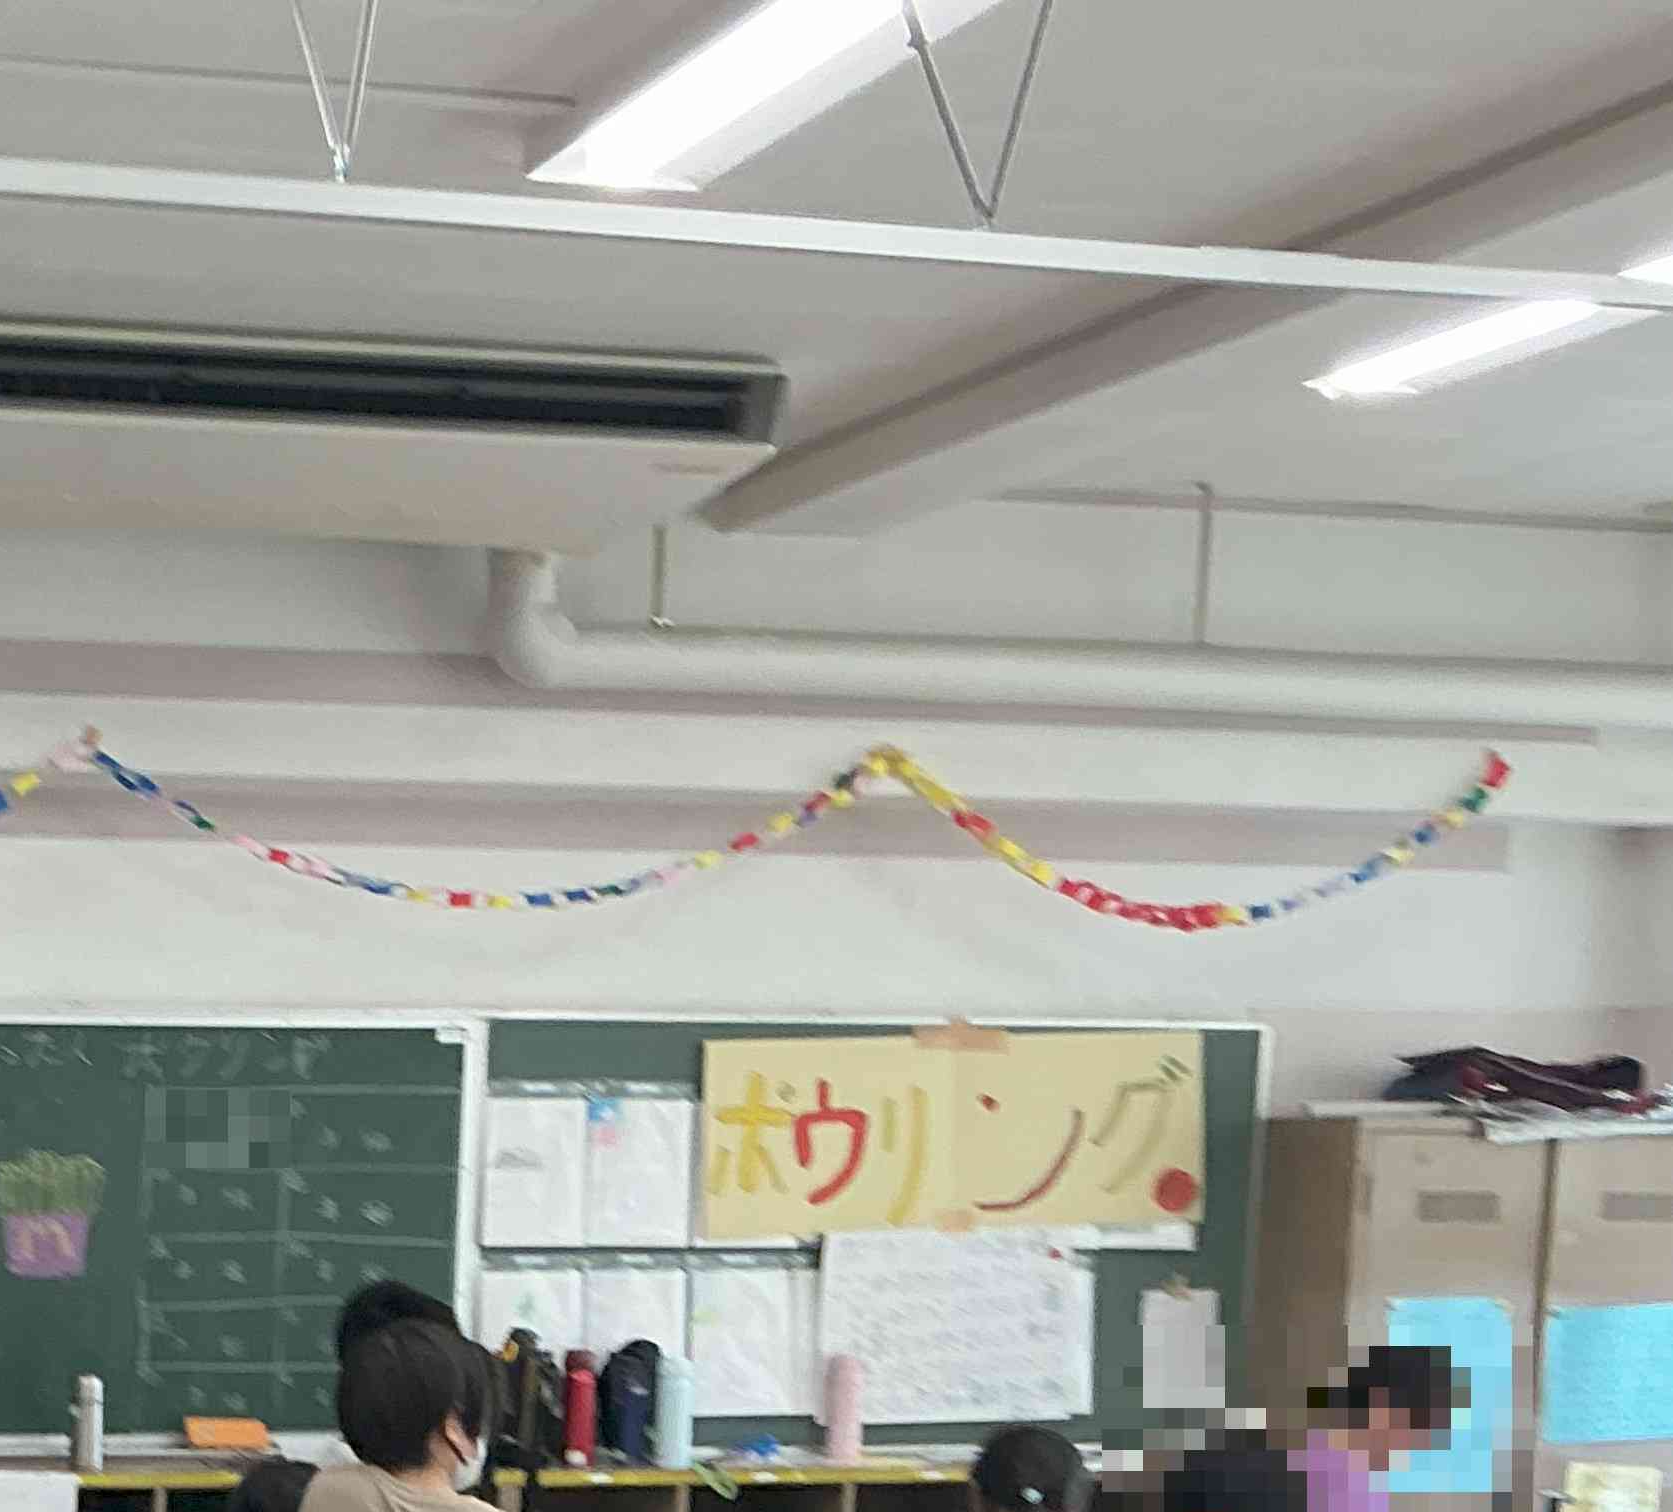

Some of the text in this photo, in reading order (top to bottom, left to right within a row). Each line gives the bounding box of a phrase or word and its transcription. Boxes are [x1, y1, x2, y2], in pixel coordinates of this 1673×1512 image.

[705, 1055, 1191, 1225] ボウリング
